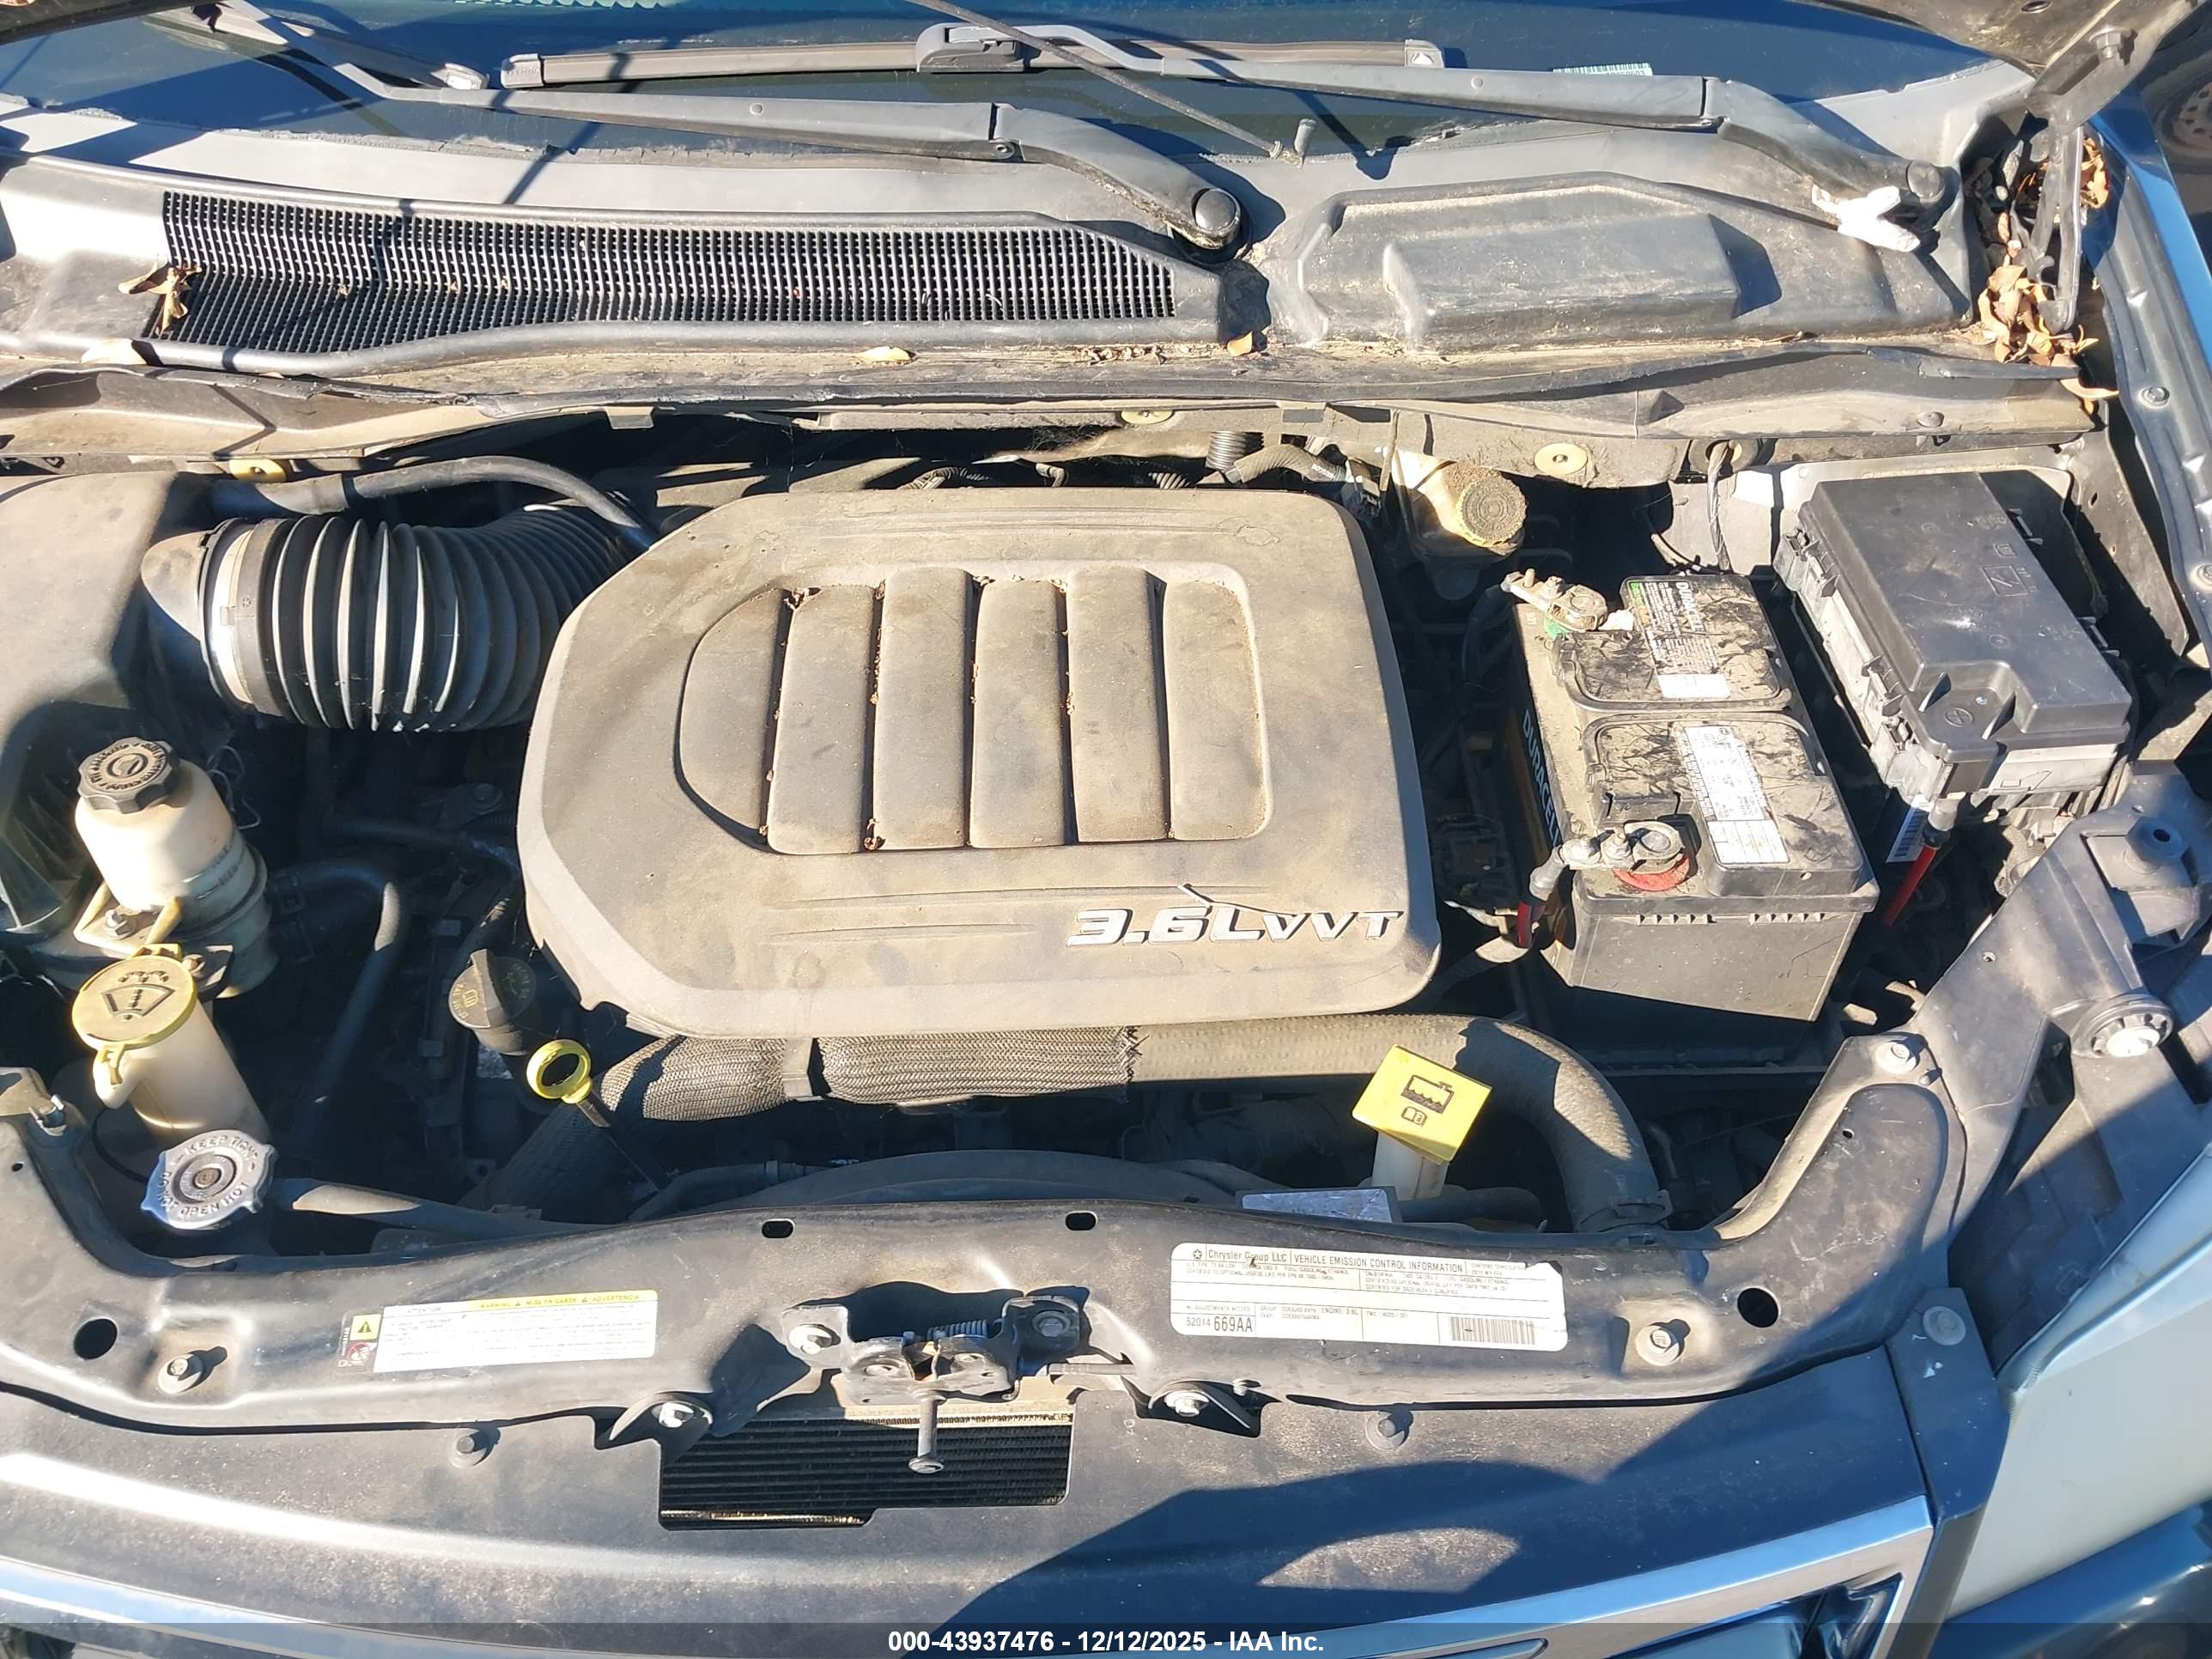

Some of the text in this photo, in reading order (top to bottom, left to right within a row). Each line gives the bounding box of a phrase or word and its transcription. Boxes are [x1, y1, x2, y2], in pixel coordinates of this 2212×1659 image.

[185, 1134, 259, 1162] KEEP TIGHT
[179, 1202, 221, 1217] OPEN
[220, 1182, 249, 1208] HOT
[1208, 1249, 1242, 1261] Chrysler
[1244, 1250, 1269, 1263] Group
[1272, 1252, 1288, 1263] LLC
[1293, 1255, 1328, 1265] VEHICLE
[1329, 1255, 1367, 1267] EMISSION
[1370, 1259, 1407, 1270] CONTROL
[1409, 1261, 1463, 1273] INFORMATION
[1186, 1316, 1211, 1328] 52014
[1213, 1316, 1253, 1332] 669AA
